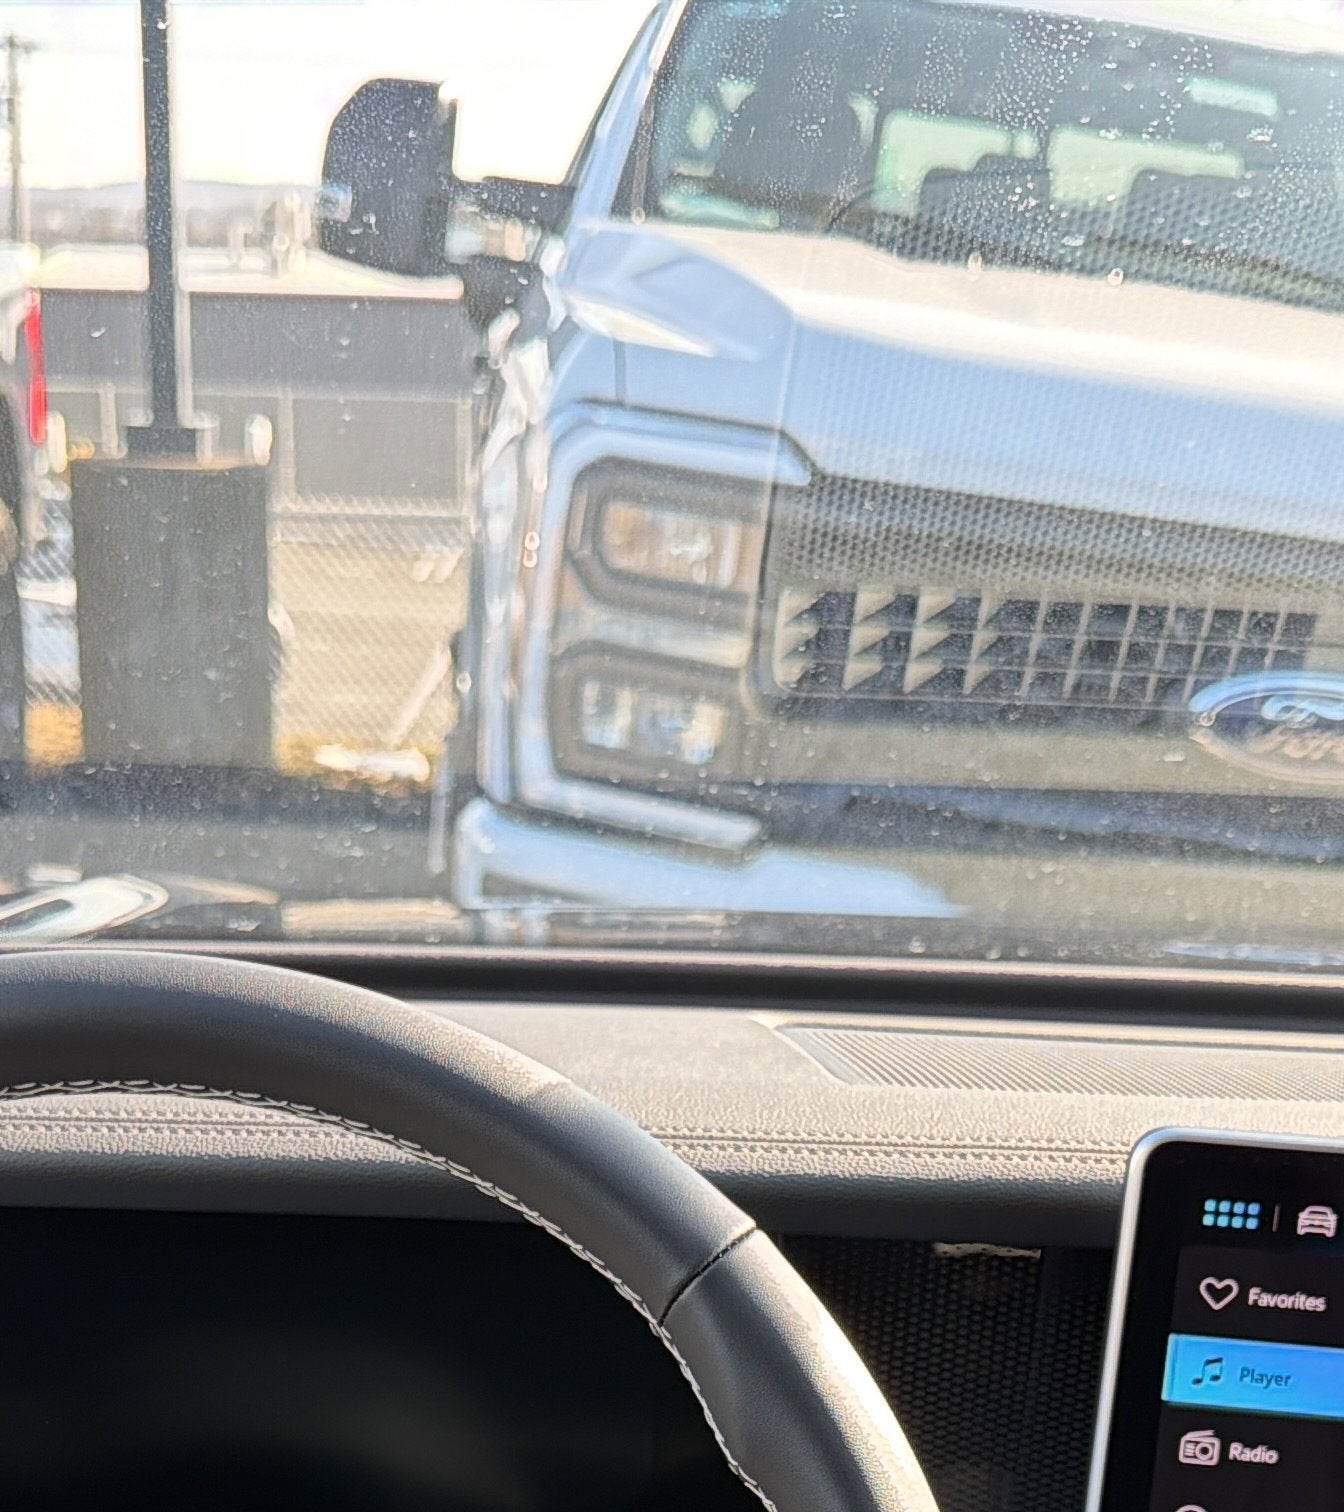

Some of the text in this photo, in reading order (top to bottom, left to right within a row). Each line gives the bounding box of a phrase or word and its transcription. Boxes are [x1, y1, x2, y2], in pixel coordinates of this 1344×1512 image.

[1248, 1287, 1326, 1312] Favorites
[1239, 1368, 1291, 1389] Player
[1229, 1442, 1279, 1465] Radio
